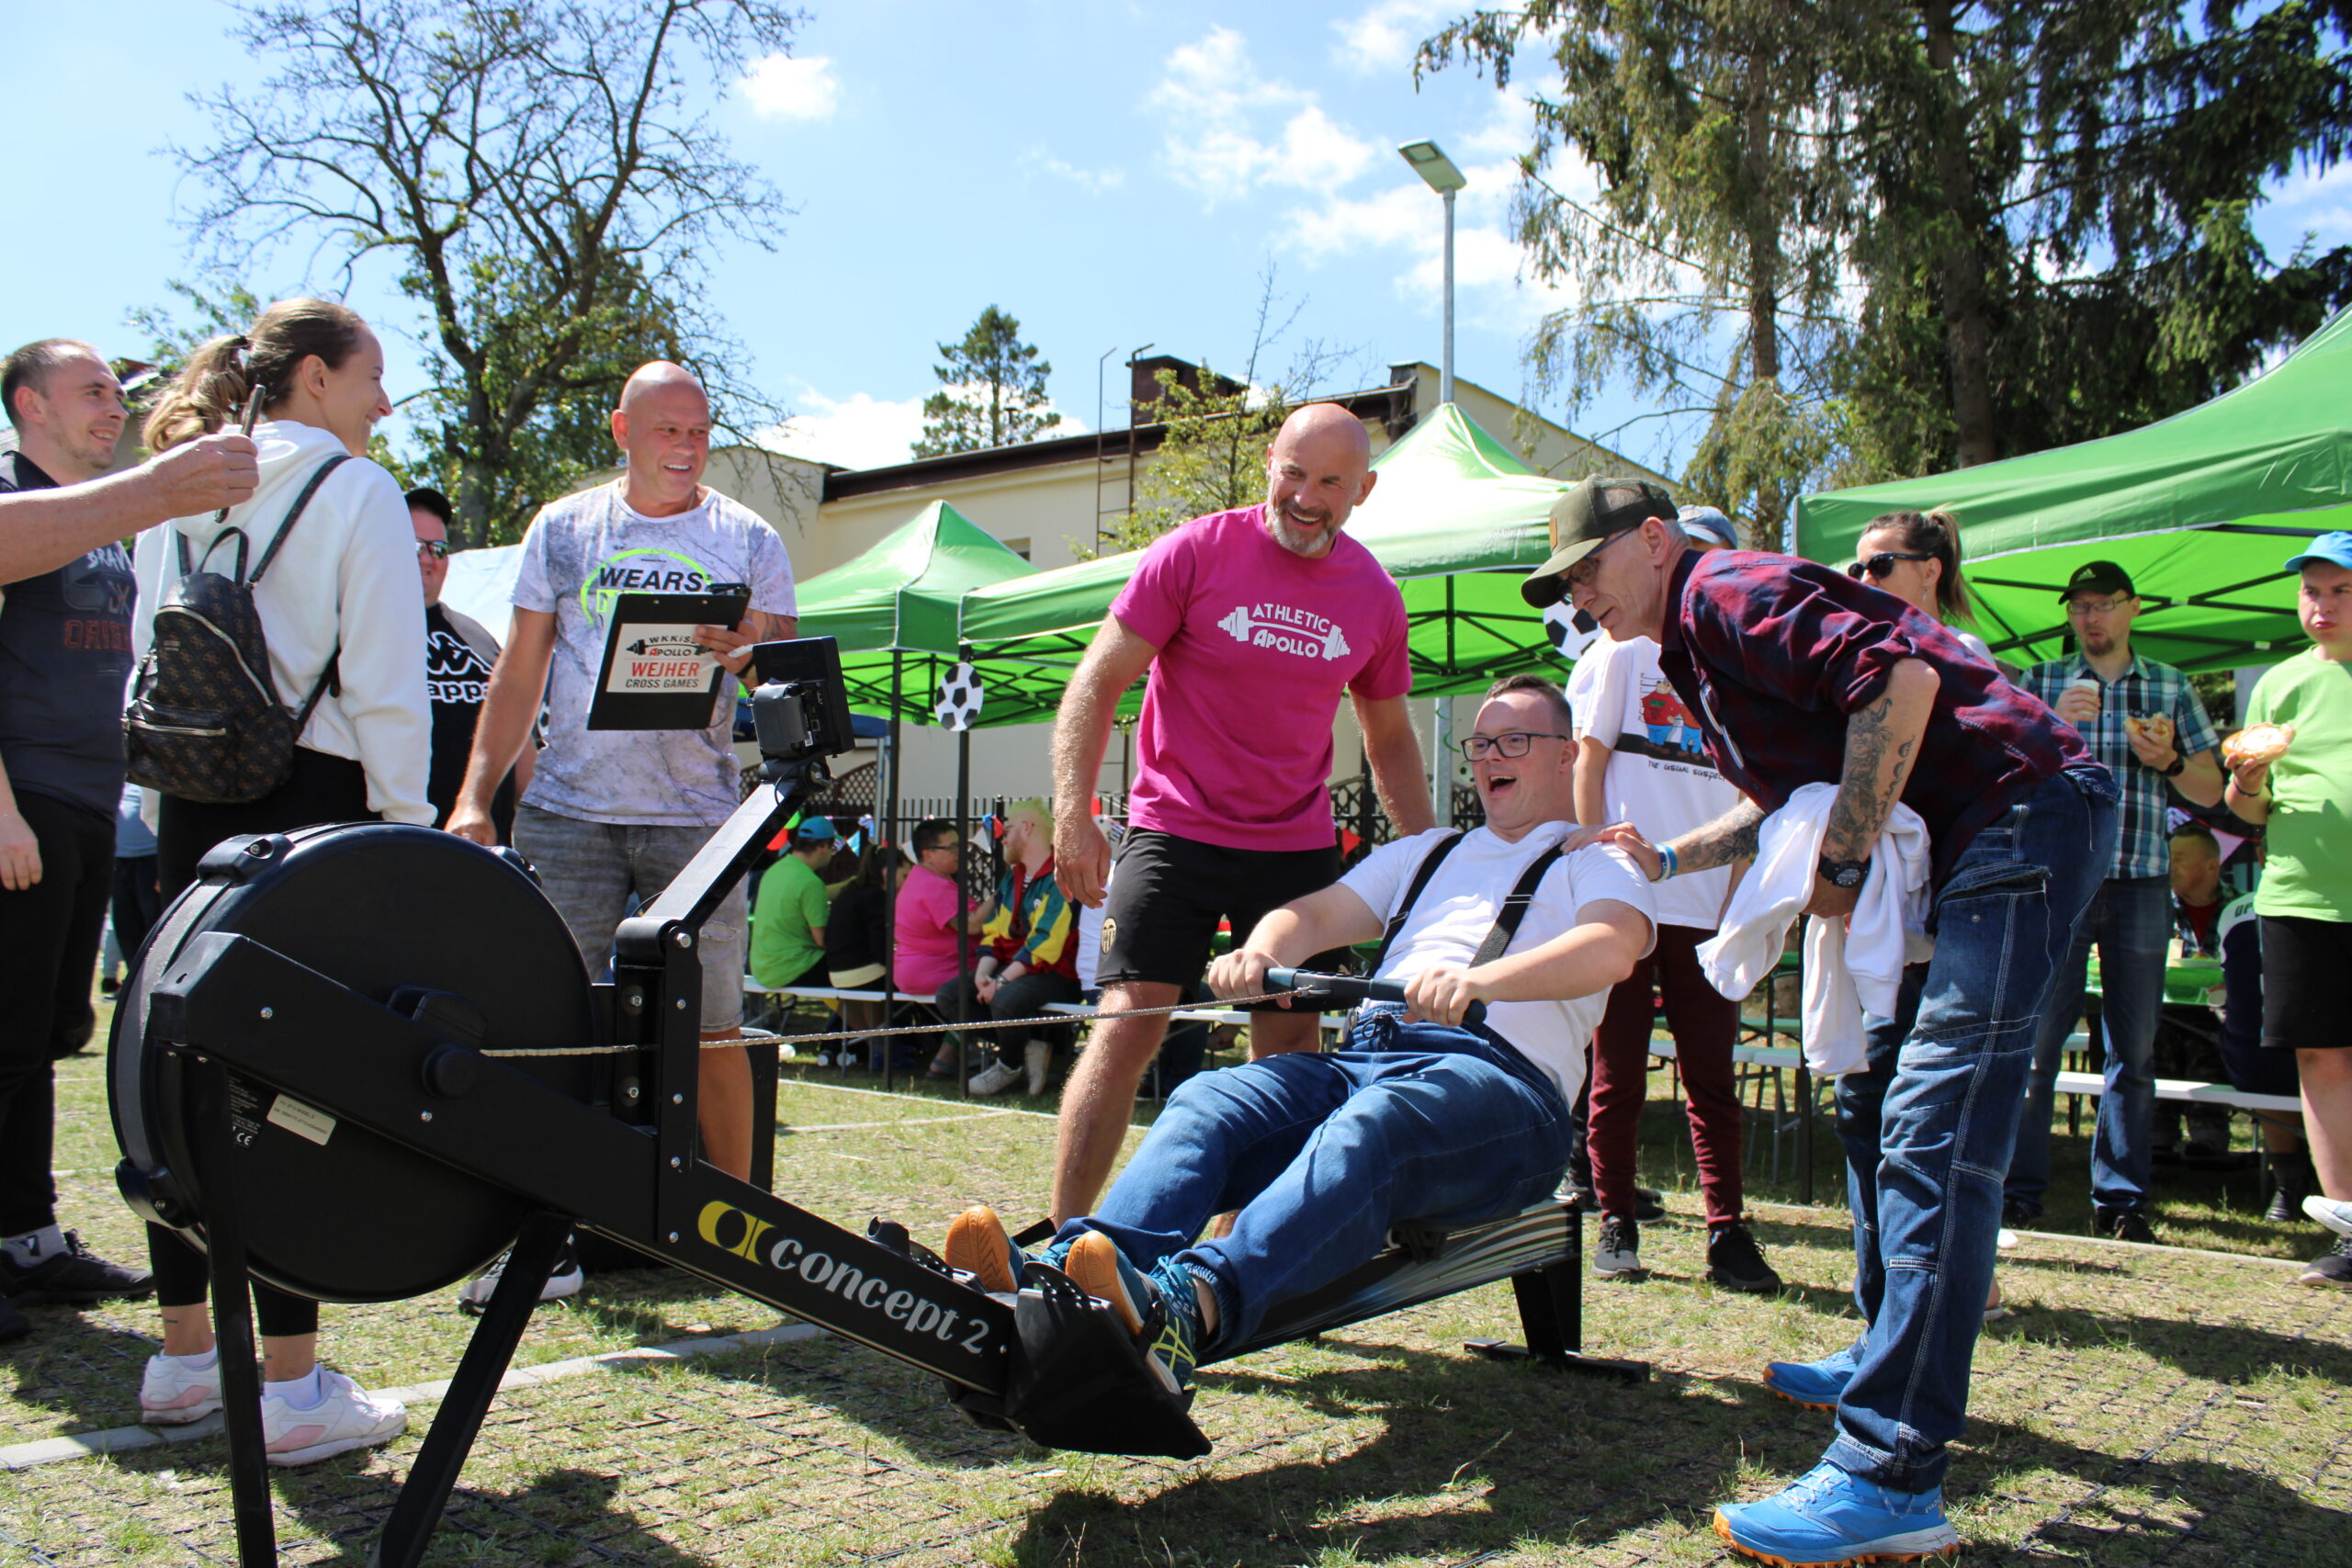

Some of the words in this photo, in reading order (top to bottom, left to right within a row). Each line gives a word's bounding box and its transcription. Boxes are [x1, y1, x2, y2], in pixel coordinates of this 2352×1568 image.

[600, 567, 704, 592] WEARS
[1252, 603, 1330, 633] ATHLETIC
[649, 647, 692, 657] APOLLO
[1252, 628, 1318, 658] APOLLO
[631, 661, 701, 677] WEJHER
[625, 678, 661, 688] CROSS
[663, 678, 699, 688] GAMES
[770, 1237, 960, 1342] concept
[960, 1318, 991, 1354] 2
